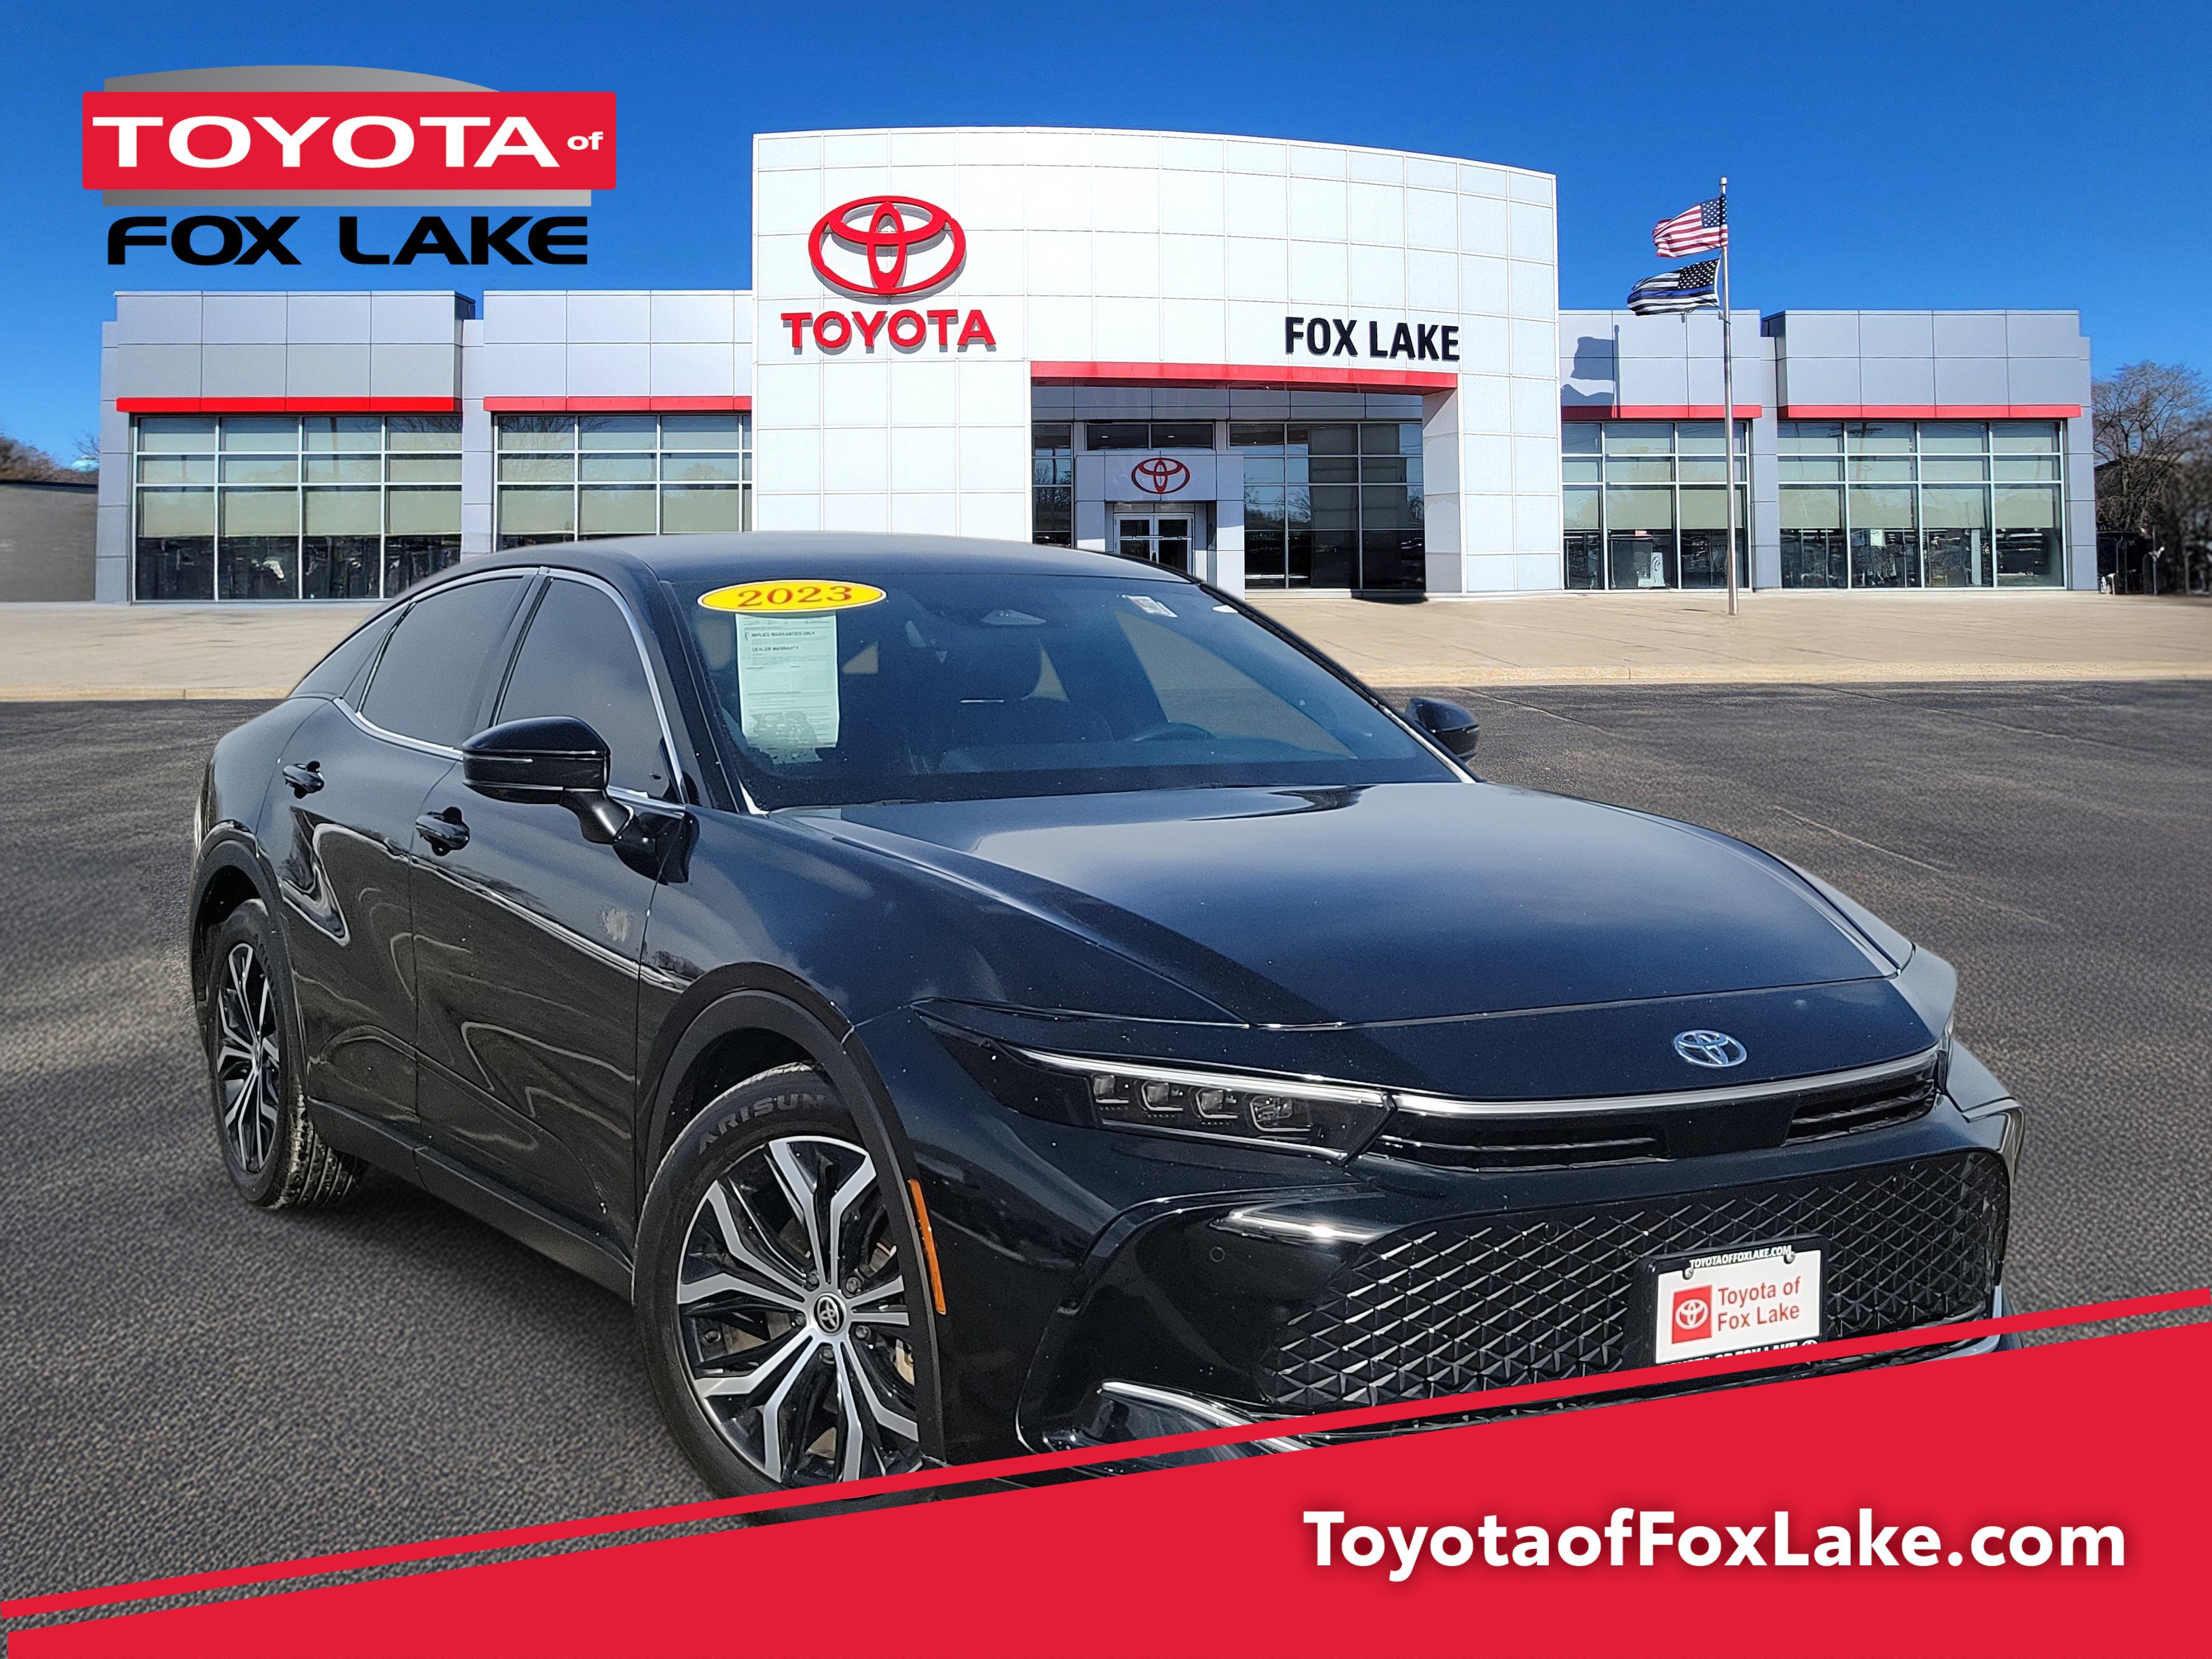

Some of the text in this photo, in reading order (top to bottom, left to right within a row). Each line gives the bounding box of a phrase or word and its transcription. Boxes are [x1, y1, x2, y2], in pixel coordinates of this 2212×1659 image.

[781, 309, 996, 353] TOYOTA
[1285, 317, 1460, 361] FOX LAKE
[738, 585, 852, 607] 2023
[699, 1093, 826, 1154] ARISUN
[1689, 1245, 1792, 1268] TOYOTAOFFOXLAKE.COM
[1718, 1276, 1801, 1308] Toyota of
[1718, 1303, 1800, 1331] Fox Lake
